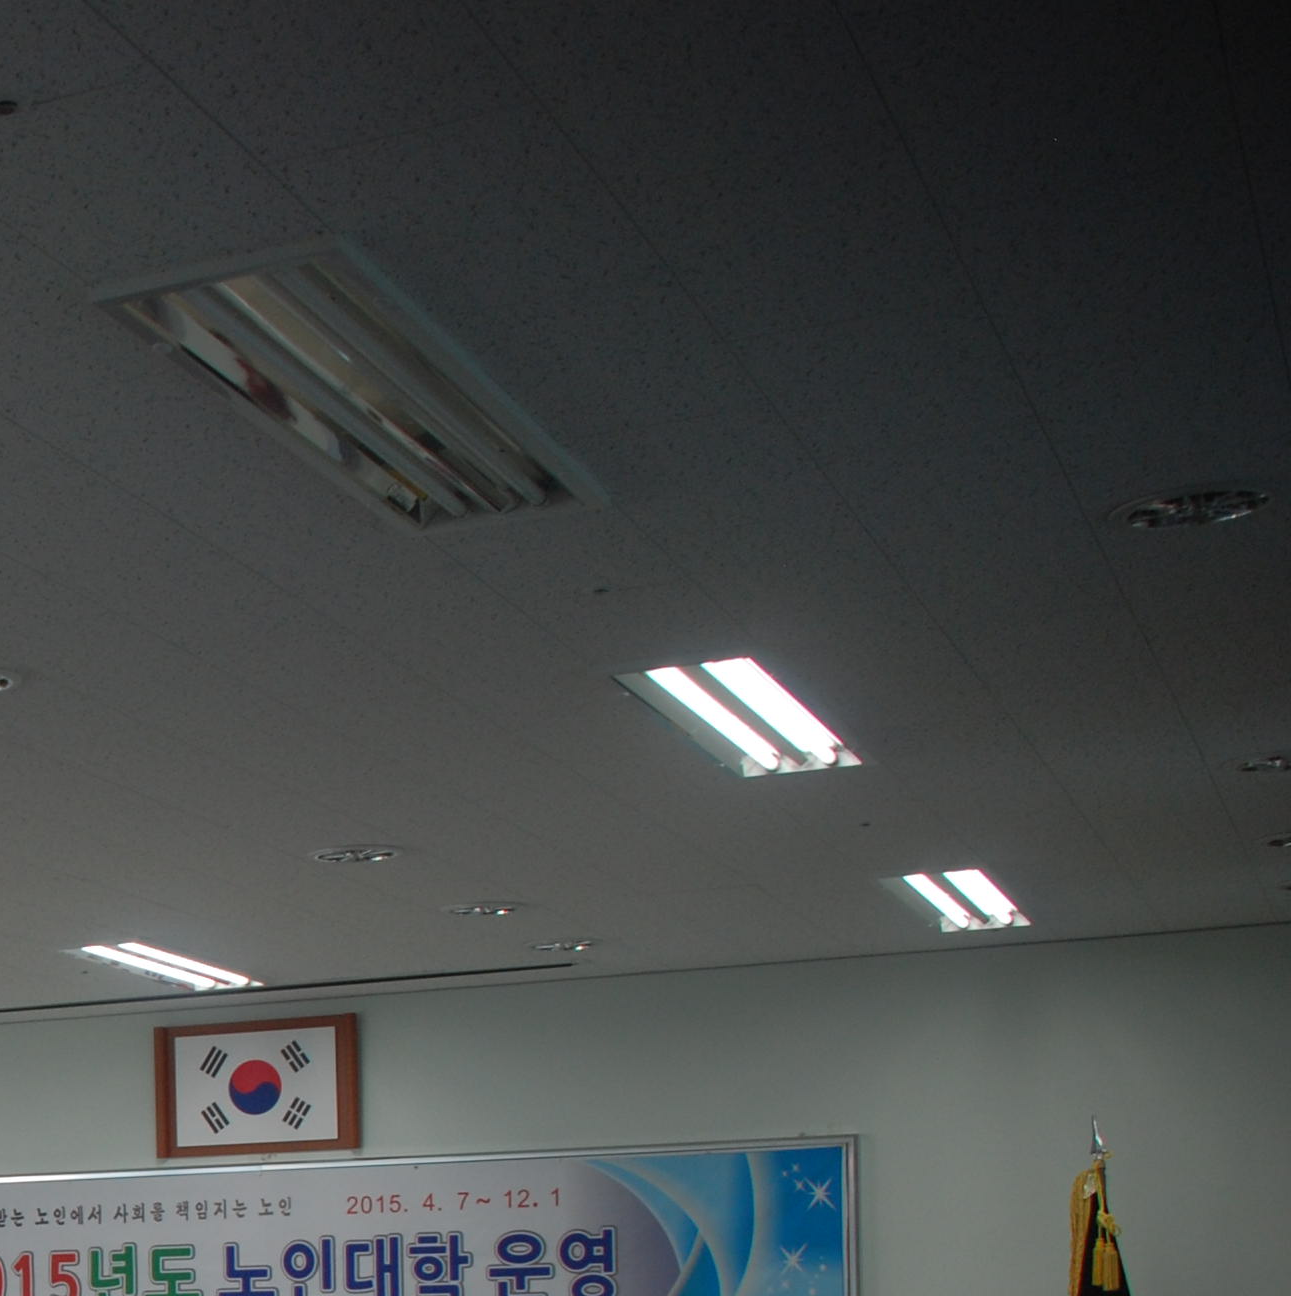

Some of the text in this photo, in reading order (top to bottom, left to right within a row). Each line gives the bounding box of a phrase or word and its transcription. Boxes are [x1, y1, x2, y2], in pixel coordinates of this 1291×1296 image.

[34, 1204, 103, 1227] 노인에서
[113, 1201, 166, 1224] 사회를
[175, 1198, 248, 1222] 책임지는
[258, 1195, 293, 1218] 노인
[346, 1195, 409, 1215] 2015.
[422, 1193, 443, 1213] 4.
[550, 1187, 561, 1207] 1
